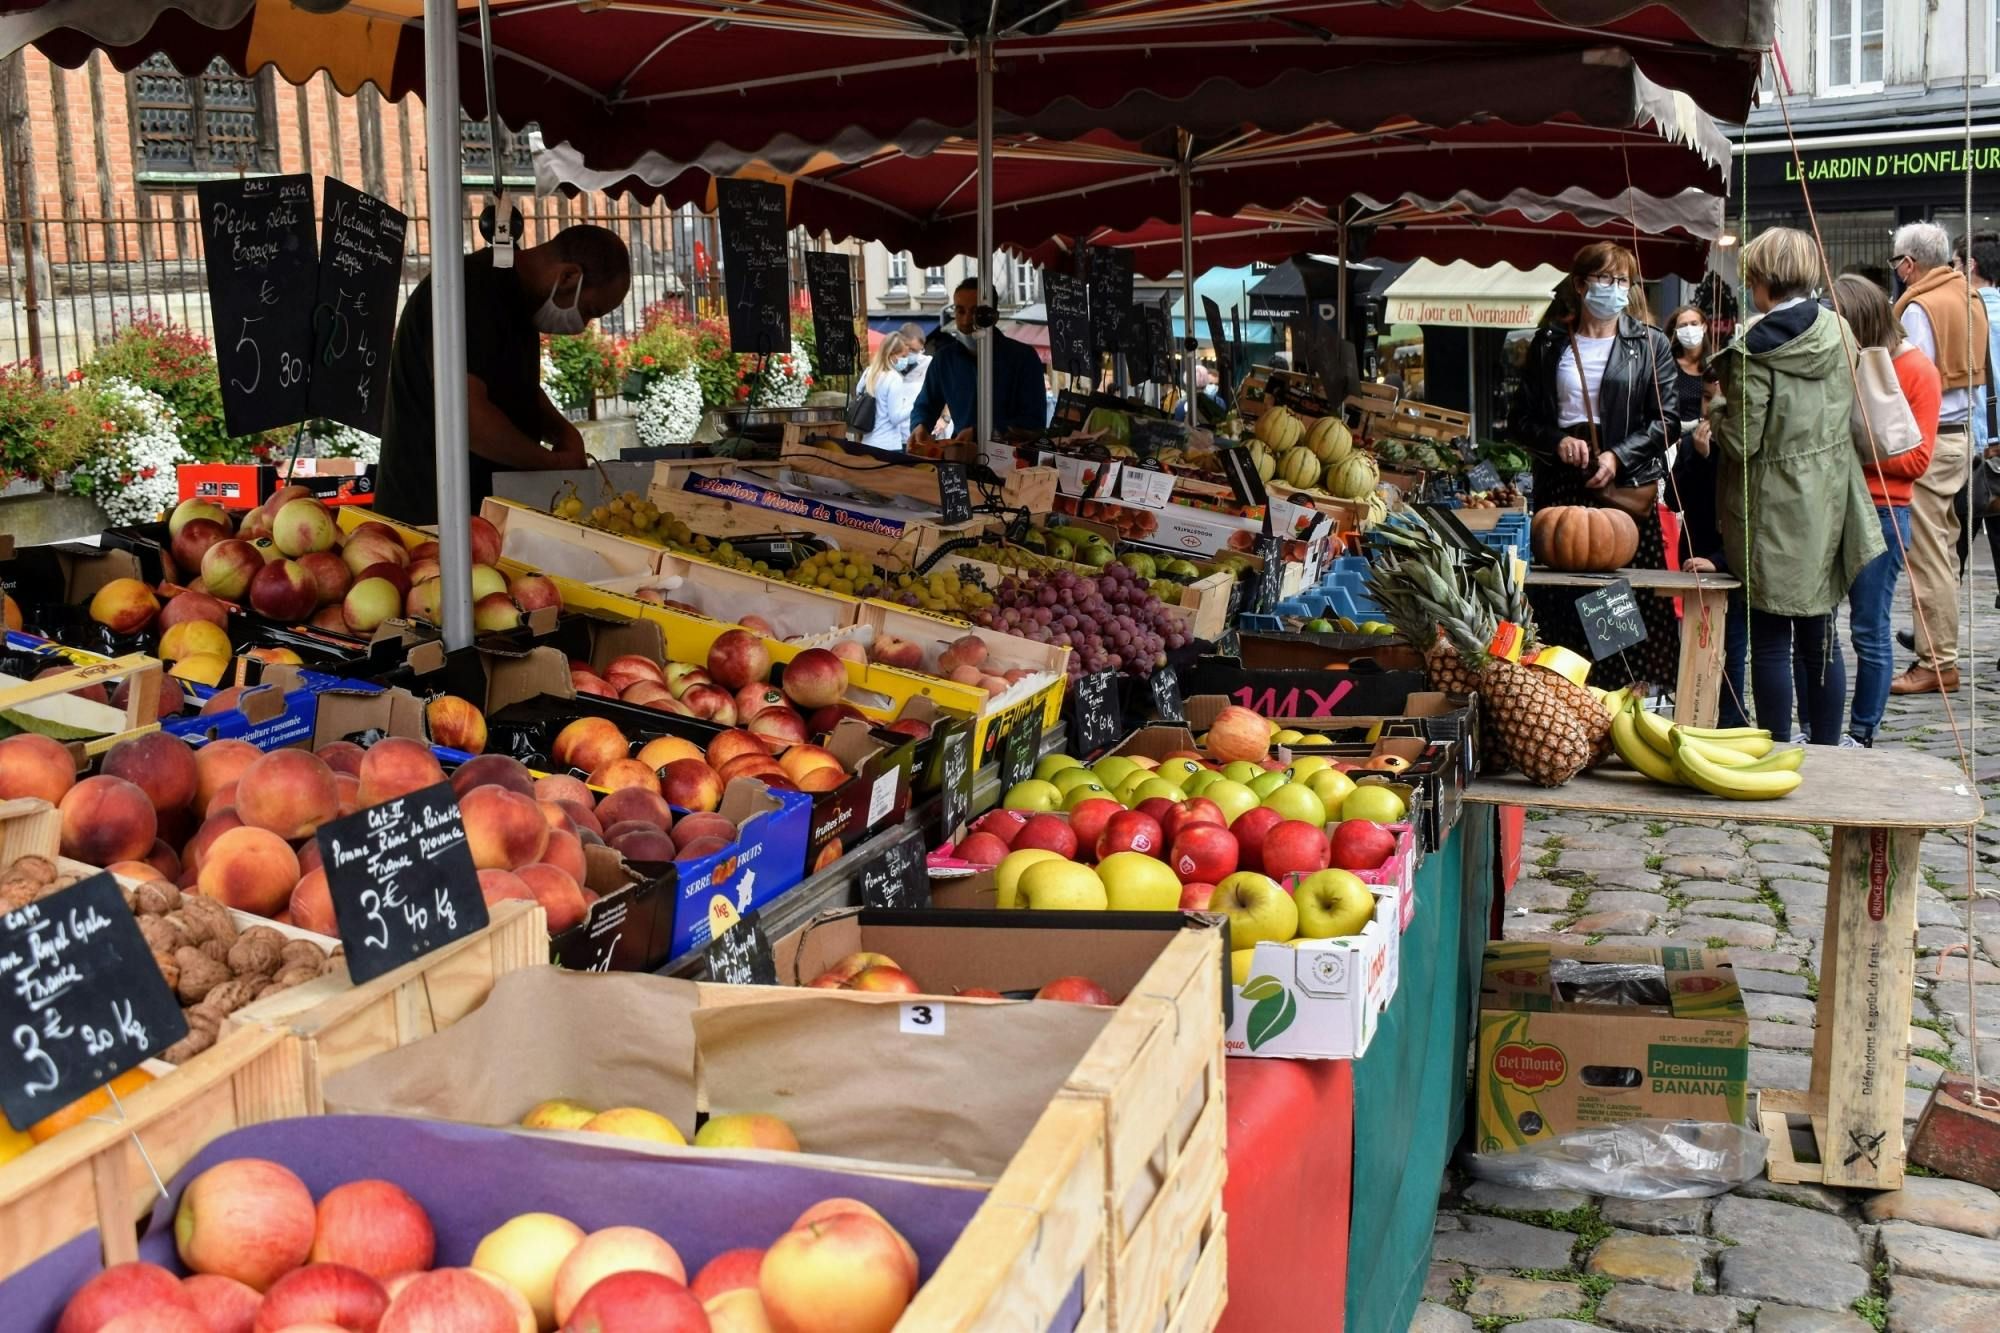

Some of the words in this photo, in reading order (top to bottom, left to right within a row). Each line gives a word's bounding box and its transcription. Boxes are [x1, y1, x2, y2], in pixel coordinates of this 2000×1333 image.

[1785, 161, 1805, 181] LE
[1808, 156, 1871, 180] JARDIN
[1876, 147, 2000, 176] D'HONFLEUR
[1397, 303, 1414, 320] Un
[1418, 303, 1445, 322] Jour
[1449, 309, 1462, 321] en
[1466, 303, 1534, 324] Normandie
[231, 317, 264, 394] 5
[280, 352, 303, 387] 30
[762, 490, 809, 516] Monts
[812, 503, 830, 520] de
[835, 508, 905, 539] Vaucluse
[1596, 617, 1611, 640] 2
[1084, 713, 1093, 740] 3
[838, 807, 853, 823] font
[332, 839, 369, 868] Pomme
[377, 830, 409, 856] Reine
[411, 823, 424, 838] de
[423, 805, 462, 831] Reinette
[367, 854, 413, 878] France
[684, 872, 712, 899] SERRE
[737, 842, 763, 867] FRUITS
[713, 902, 731, 919] 1kg
[1871, 885, 1884, 916] PRINCE
[360, 888, 388, 949] 3
[382, 880, 408, 908] €
[404, 903, 428, 933] 40
[435, 887, 457, 929] Kg
[1868, 942, 1880, 971] frais
[16, 963, 83, 1000] France
[1868, 973, 1879, 988] du
[911, 1005, 933, 1025] 3
[1866, 990, 1879, 1017] goût
[1865, 1022, 1876, 1032] le
[13, 1024, 59, 1097] 3
[44, 1008, 74, 1039] €
[112, 998, 149, 1050] Kg
[1499, 1056, 1519, 1069] Del
[1521, 1056, 1562, 1072] Monte
[1653, 1060, 1728, 1077] Premium
[1862, 1037, 1876, 1096] Défendons
[1652, 1079, 1741, 1097] BANANAS
